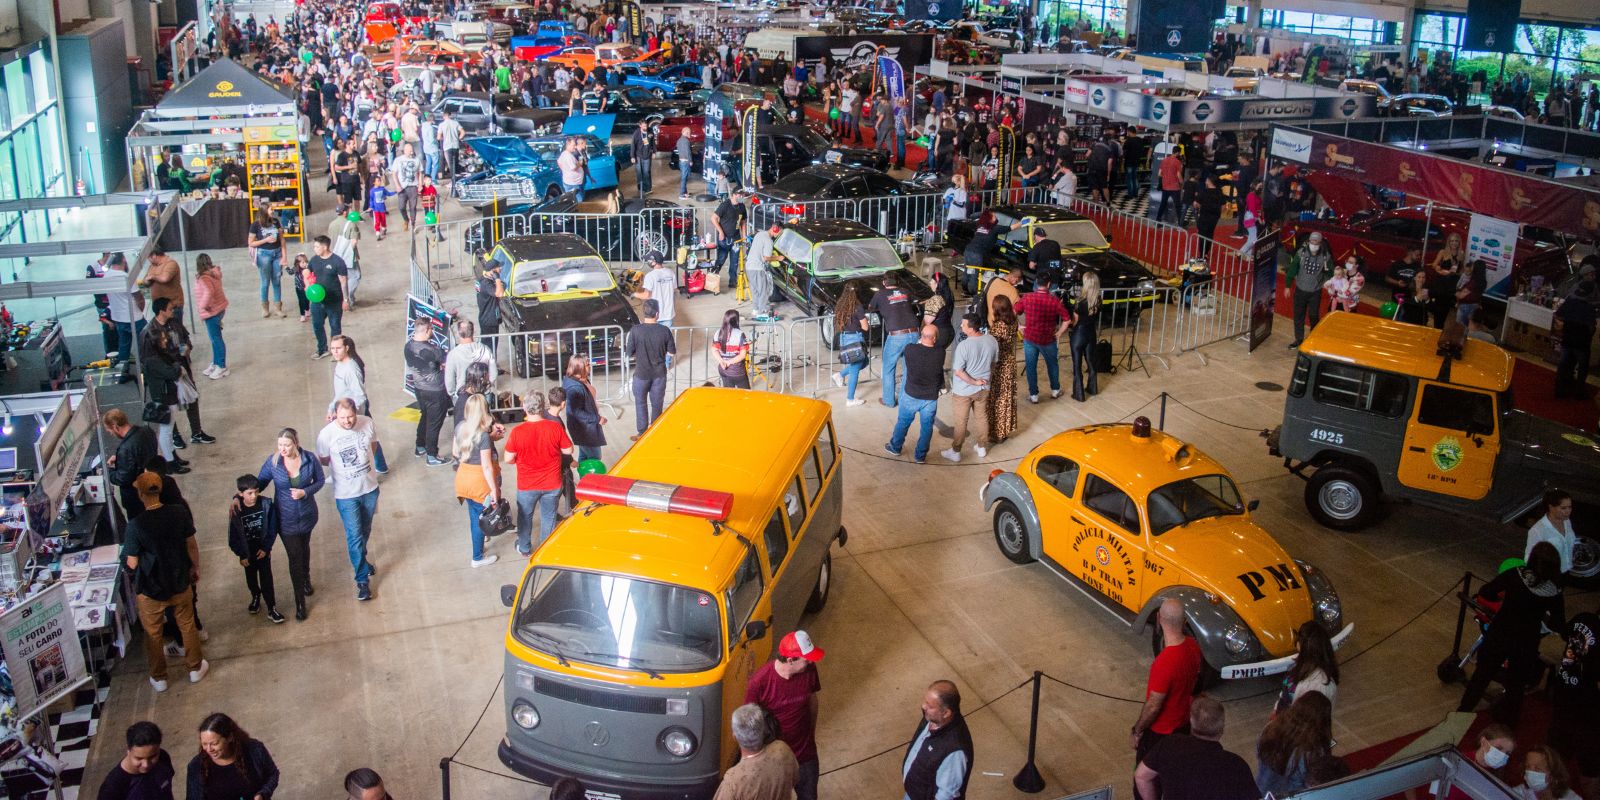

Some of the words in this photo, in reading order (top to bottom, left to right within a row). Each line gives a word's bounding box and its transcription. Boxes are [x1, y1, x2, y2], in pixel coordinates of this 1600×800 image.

[1246, 102, 1312, 117] AUTOCAR
[1310, 428, 1344, 444] 4925
[1073, 527, 1104, 552] POLÍCIA
[1106, 533, 1136, 586] MILITAR
[1144, 559, 1164, 576] 967
[1082, 572, 1104, 592] FONE
[1107, 587, 1123, 603] 190
[1090, 563, 1097, 573] P
[1098, 569, 1123, 591] TRAN
[1236, 563, 1302, 602] PM
[8, 602, 63, 642] ESTAMPAMOS
[18, 638, 25, 648] A
[25, 625, 46, 643] FOTO
[47, 618, 58, 630] DO
[18, 645, 35, 659] SEU
[36, 628, 63, 649] CARRO
[1231, 666, 1265, 679] PMPR
